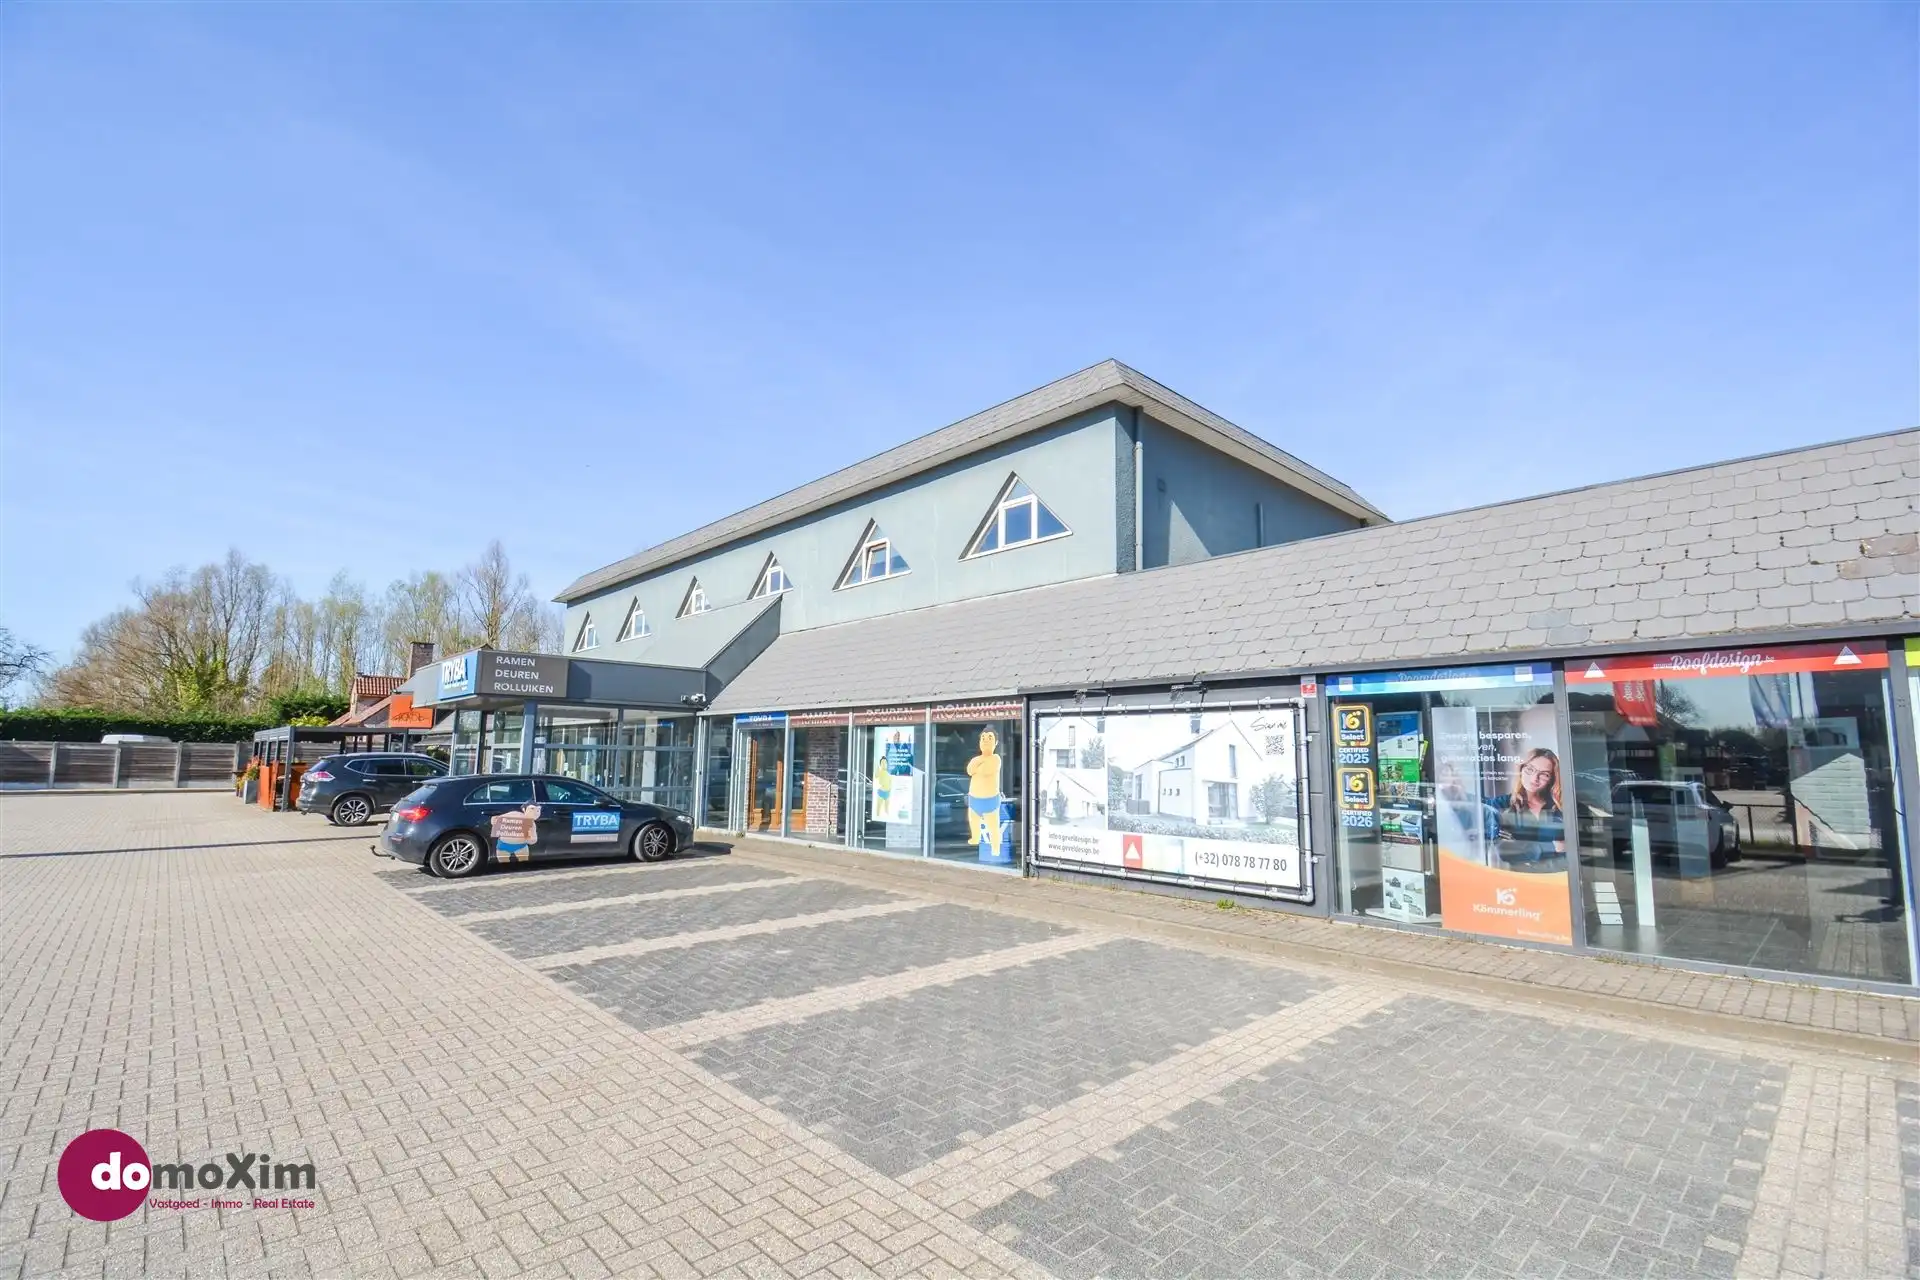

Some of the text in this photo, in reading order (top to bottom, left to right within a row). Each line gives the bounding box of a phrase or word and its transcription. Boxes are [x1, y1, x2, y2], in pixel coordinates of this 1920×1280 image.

[496, 656, 536, 667] RAMEN
[442, 657, 468, 683] TRYBA
[495, 669, 539, 680] DEUREN
[494, 682, 554, 693] ROLLUIKEN
[1339, 753, 1369, 763] 2025
[575, 814, 618, 826] TRYBA
[1342, 816, 1373, 827] 2026
[1195, 851, 1287, 871] (+32) 078 78 77 80
[1472, 903, 1541, 921] Kömmerling
